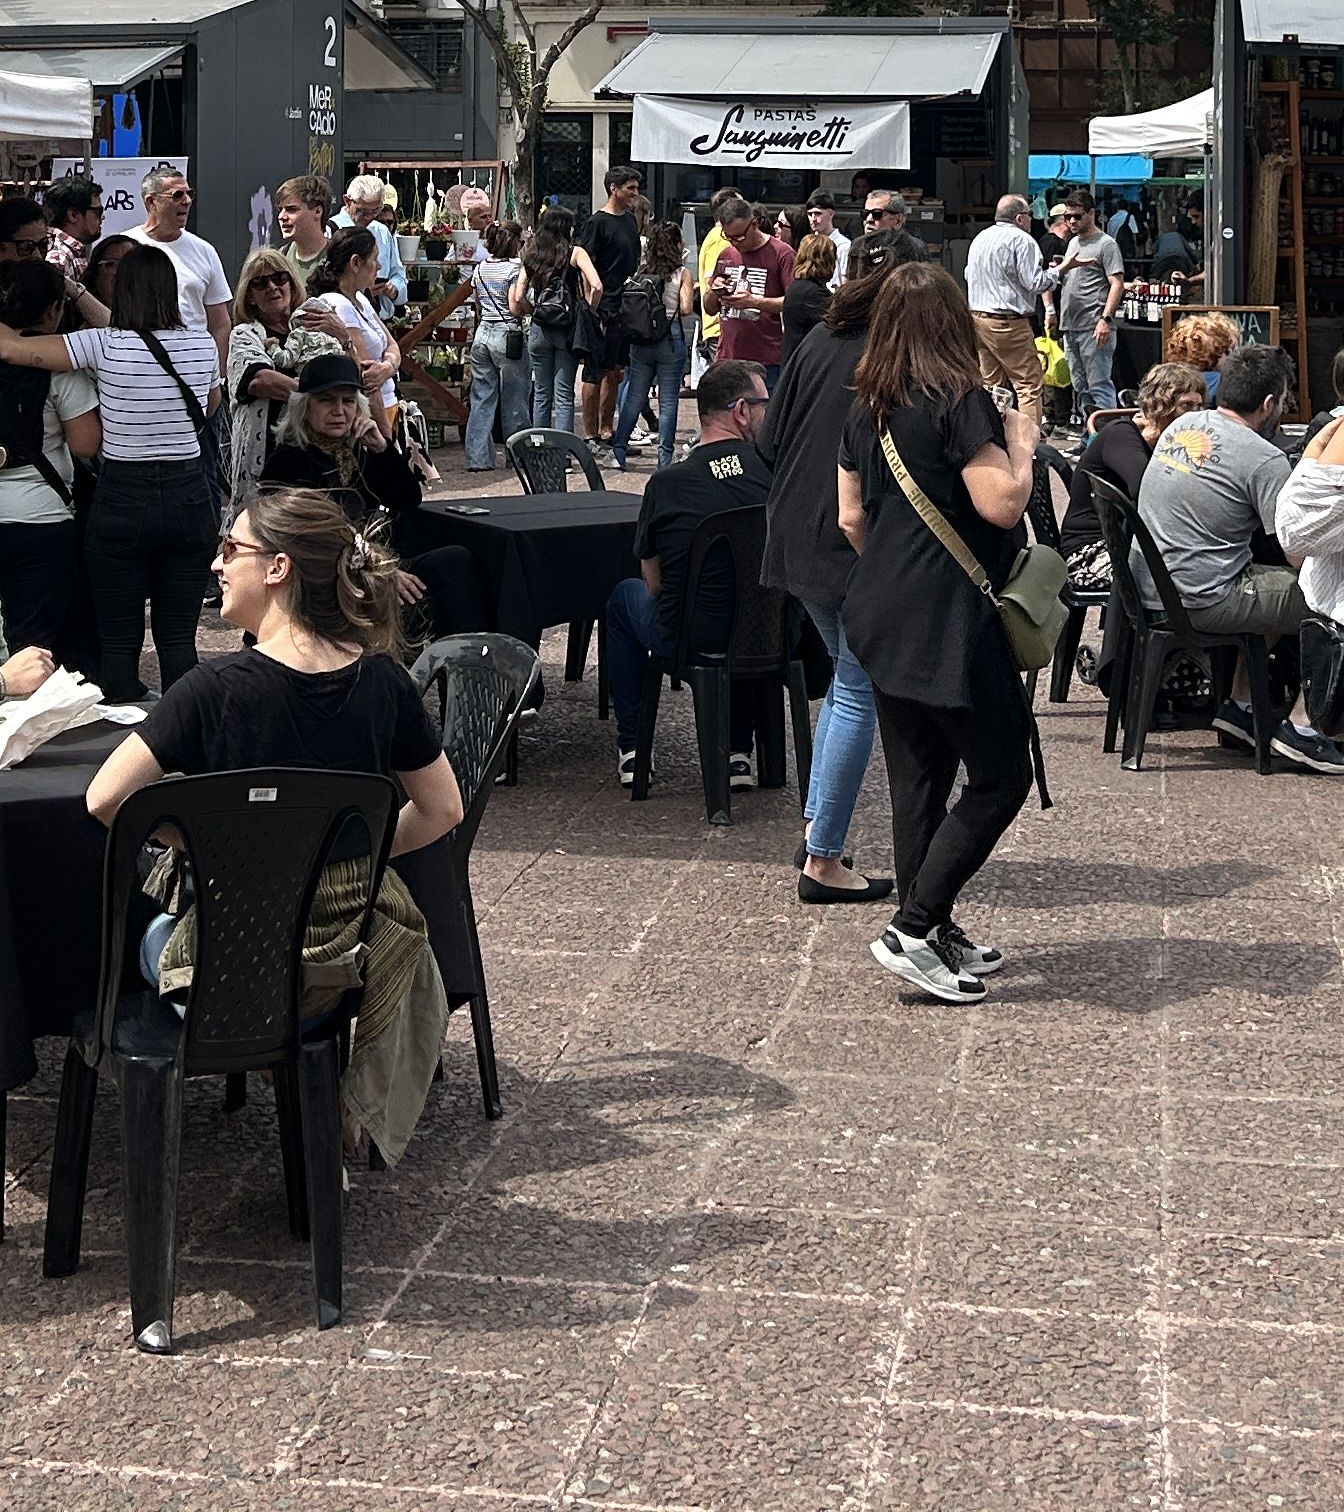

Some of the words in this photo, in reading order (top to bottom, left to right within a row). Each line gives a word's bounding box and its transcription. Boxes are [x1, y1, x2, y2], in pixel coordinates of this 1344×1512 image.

[324, 16, 337, 67] 2
[690, 104, 853, 162] Sanguinetti
[754, 109, 816, 122] PASTAS
